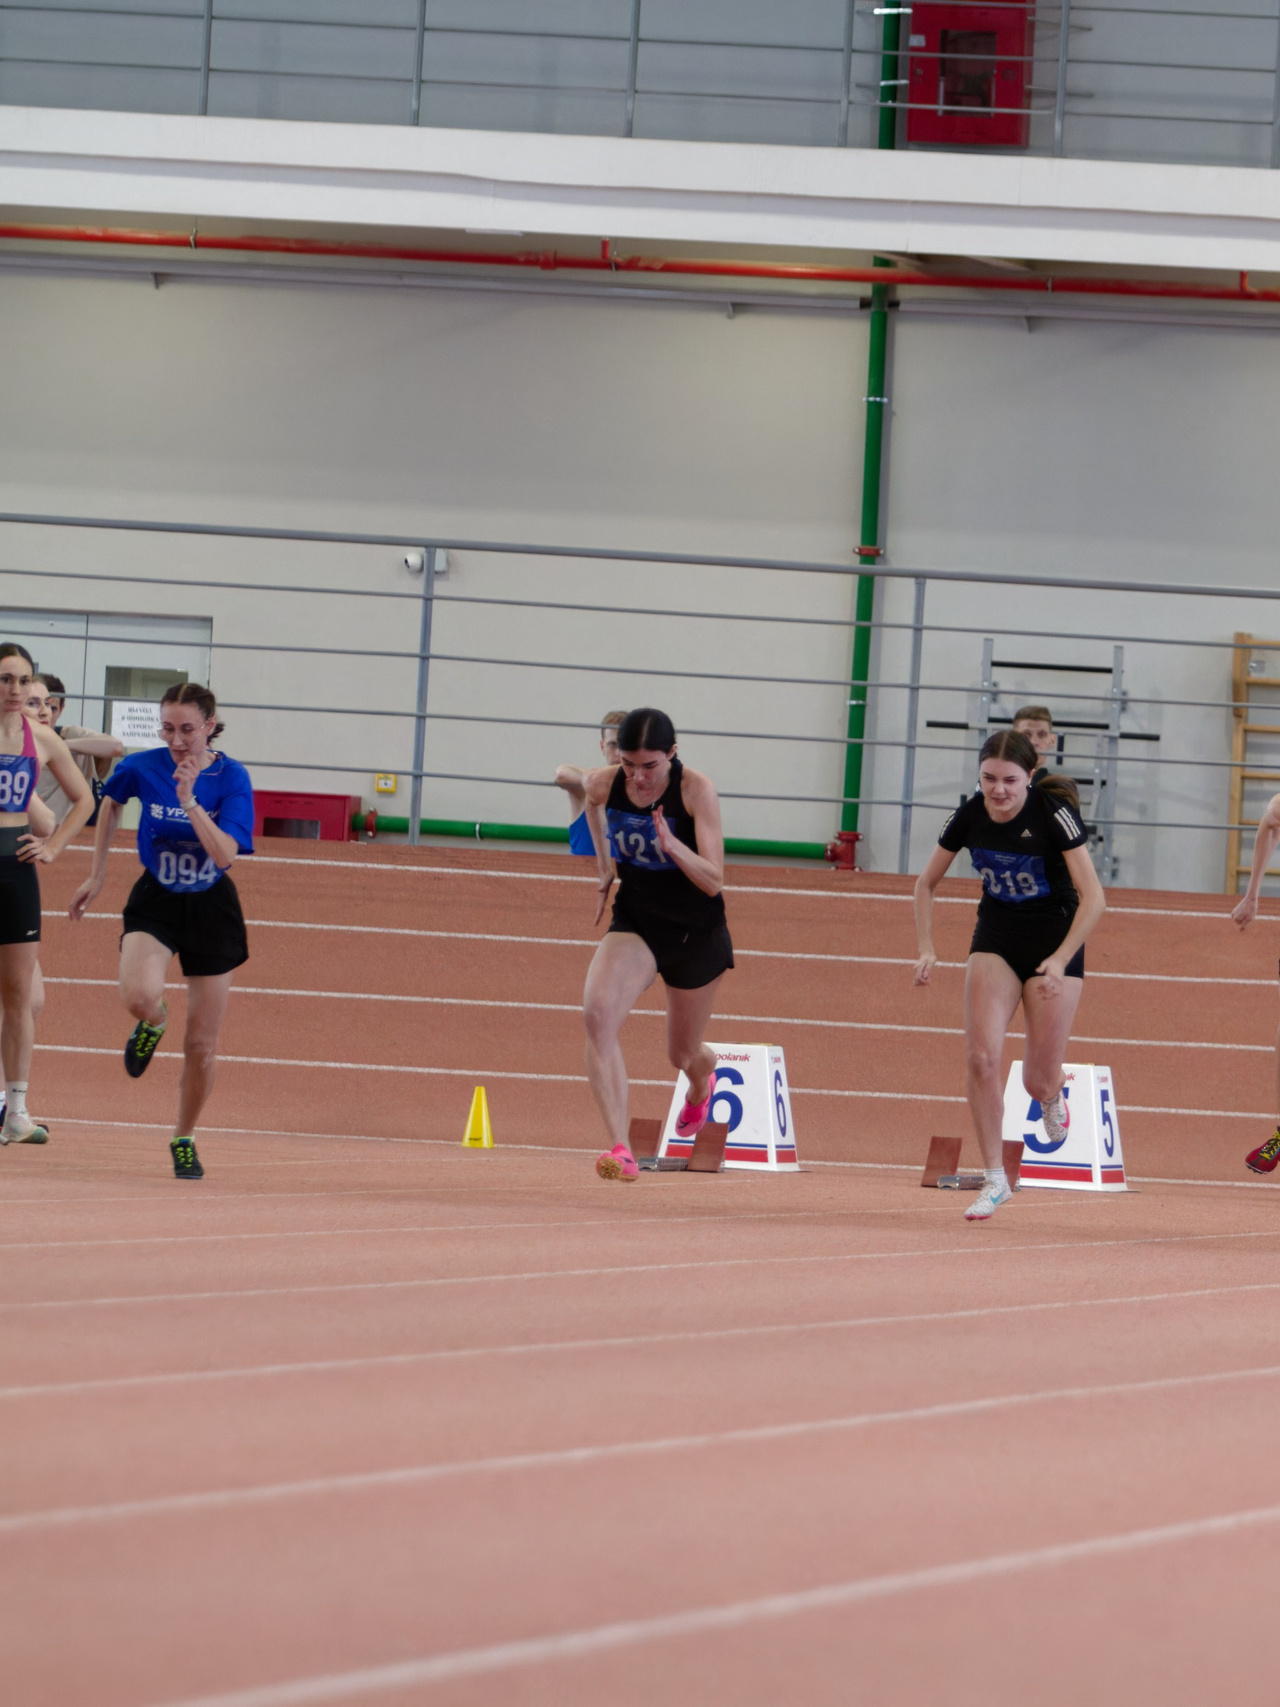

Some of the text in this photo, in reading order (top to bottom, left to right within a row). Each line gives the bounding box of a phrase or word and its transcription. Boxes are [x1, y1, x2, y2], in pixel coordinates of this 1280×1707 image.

[158, 851, 217, 885] 094
[615, 830, 667, 864] 121
[707, 1066, 744, 1133] 6
[773, 1069, 787, 1138] 6
[1100, 1089, 1114, 1158] 5
